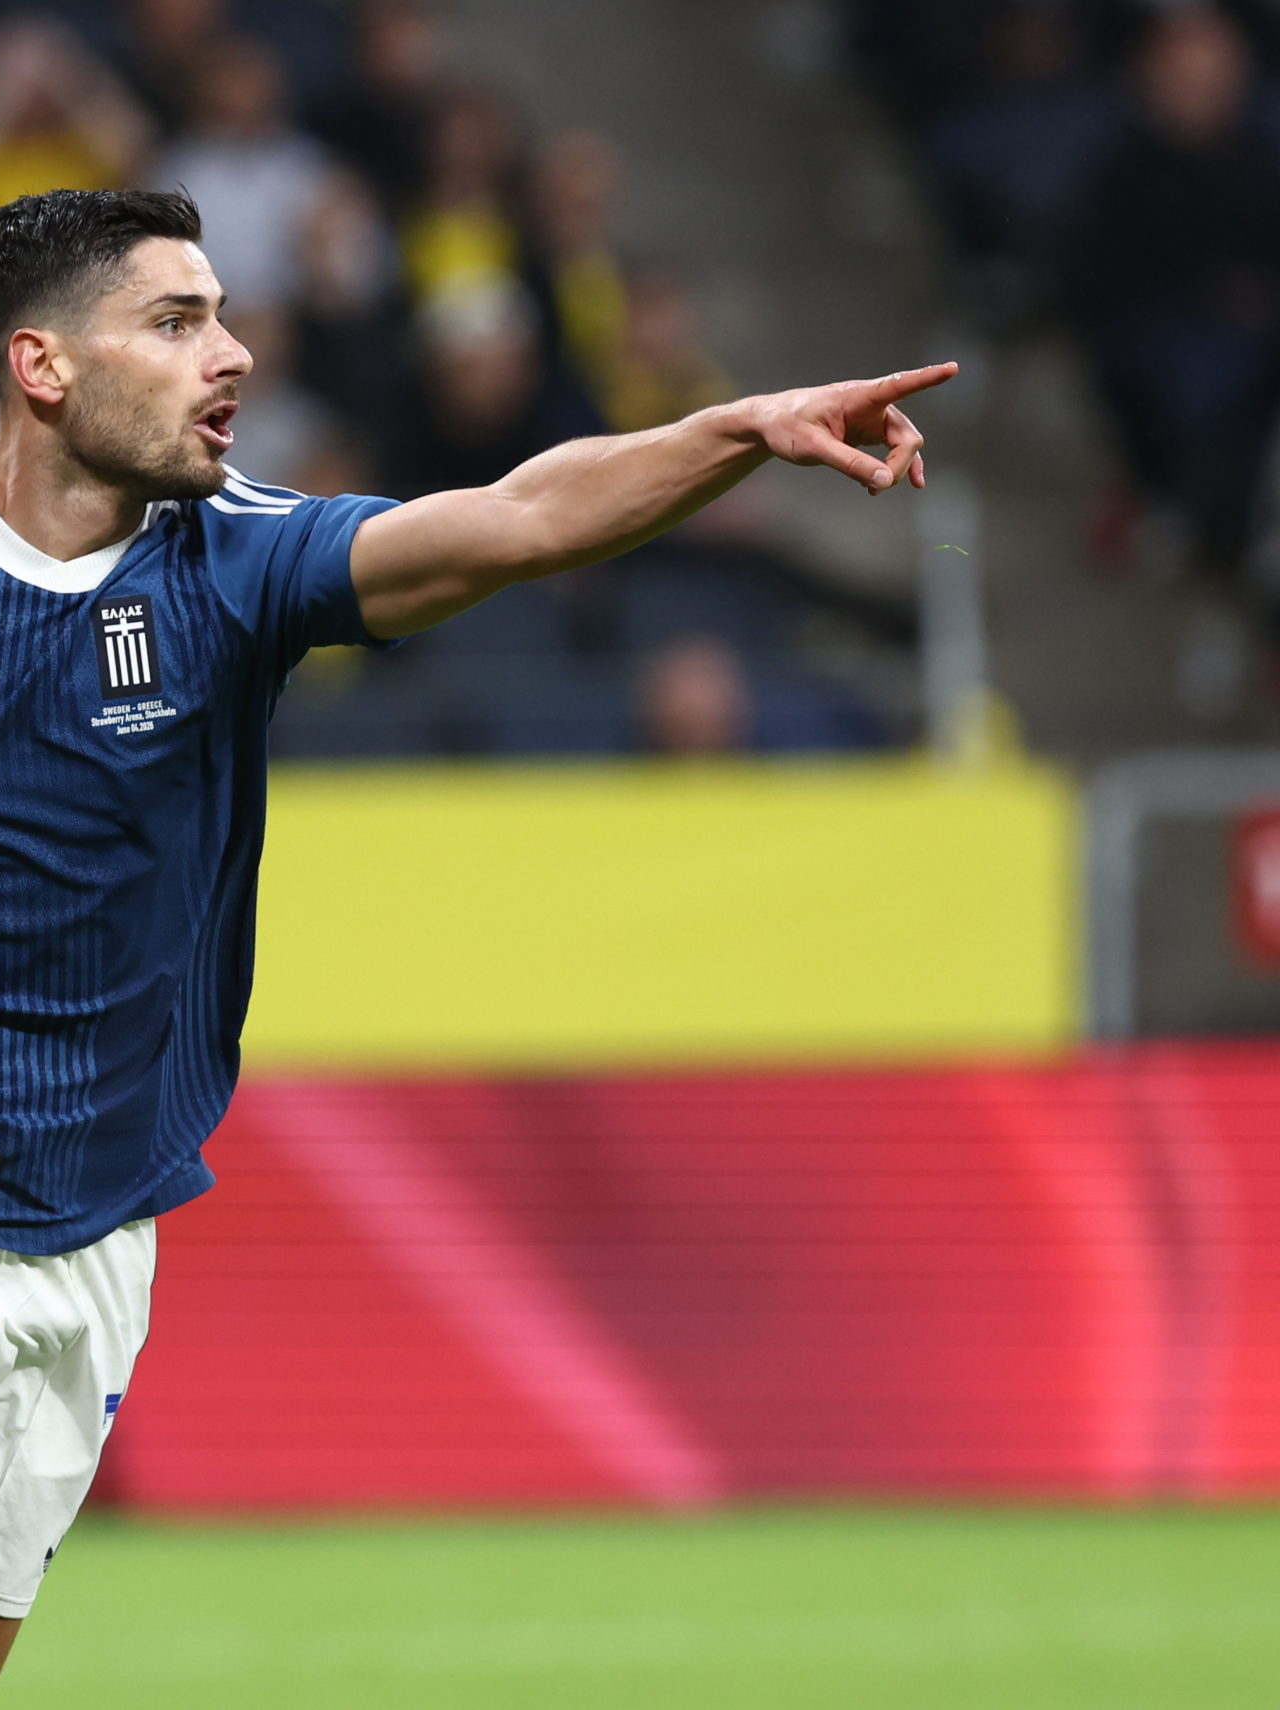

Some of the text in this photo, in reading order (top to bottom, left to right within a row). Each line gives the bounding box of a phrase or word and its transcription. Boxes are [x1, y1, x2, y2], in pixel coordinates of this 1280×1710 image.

[101, 605, 143, 620] ΕΛΛΑΣ
[103, 705, 130, 715] SWEDEN
[137, 700, 162, 711] GREECE
[91, 715, 124, 727] Strawberry
[145, 707, 176, 719] Stockholm
[117, 725, 131, 735] June
